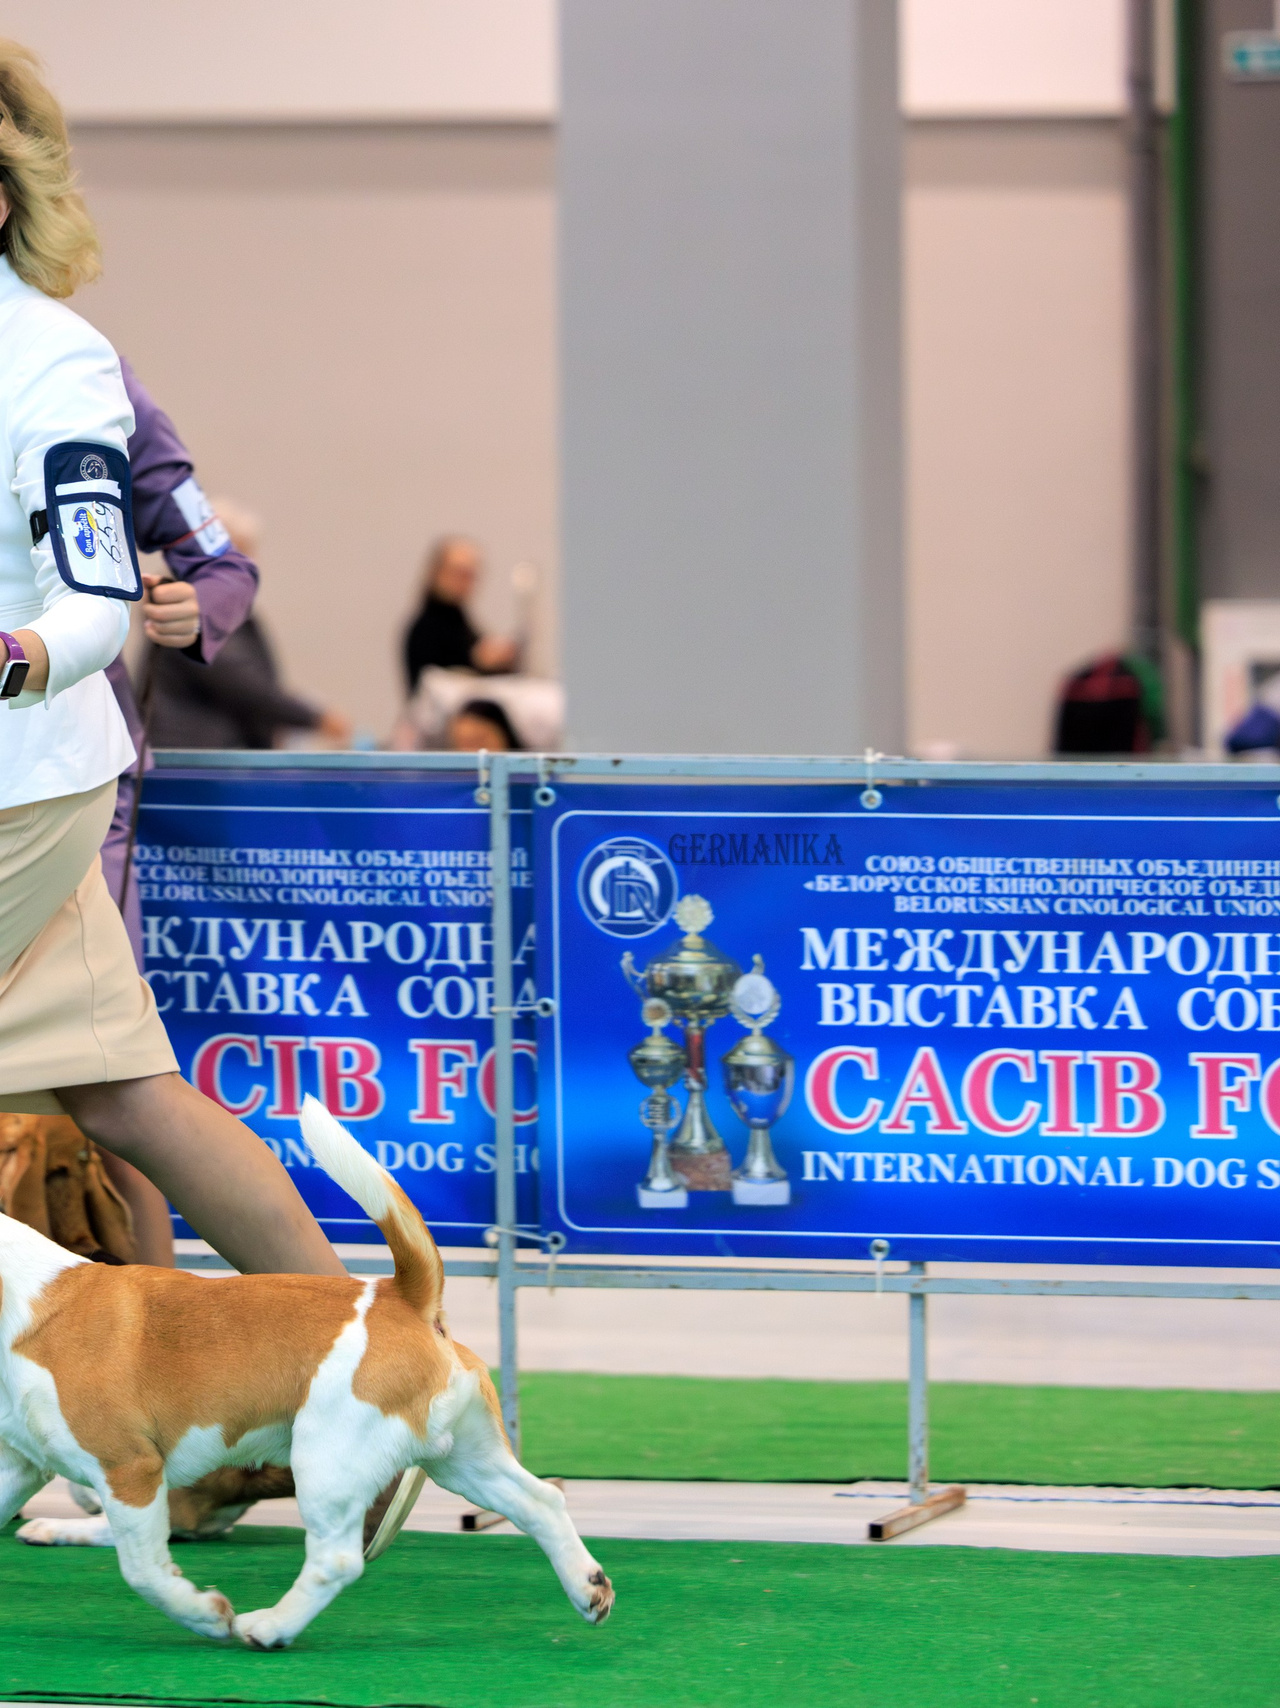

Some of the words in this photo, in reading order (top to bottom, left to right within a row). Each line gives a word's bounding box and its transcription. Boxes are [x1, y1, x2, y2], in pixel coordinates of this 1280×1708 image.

[85, 539, 93, 553] Bon
[167, 846, 351, 866] ОБЩЕСТВЕННЫХ
[866, 855, 935, 874] СОЮЗ
[938, 856, 1134, 876] ОБЩЕСТВЕННЫХ
[212, 866, 420, 887] КИНОЛОГИЧЕСКОЕ
[985, 876, 1206, 896] КИНОЛОГИЧЕСКОЕ
[277, 886, 427, 907] CINOLOGICAL
[894, 895, 1051, 915] BELORUSSIAN
[1054, 898, 1210, 917] CINOLOGICAL
[804, 1044, 1166, 1138] CACIB
[375, 1140, 465, 1173] DOG
[800, 1150, 1144, 1187] INTERNATIONAL
[1152, 1156, 1248, 1189] DOG
